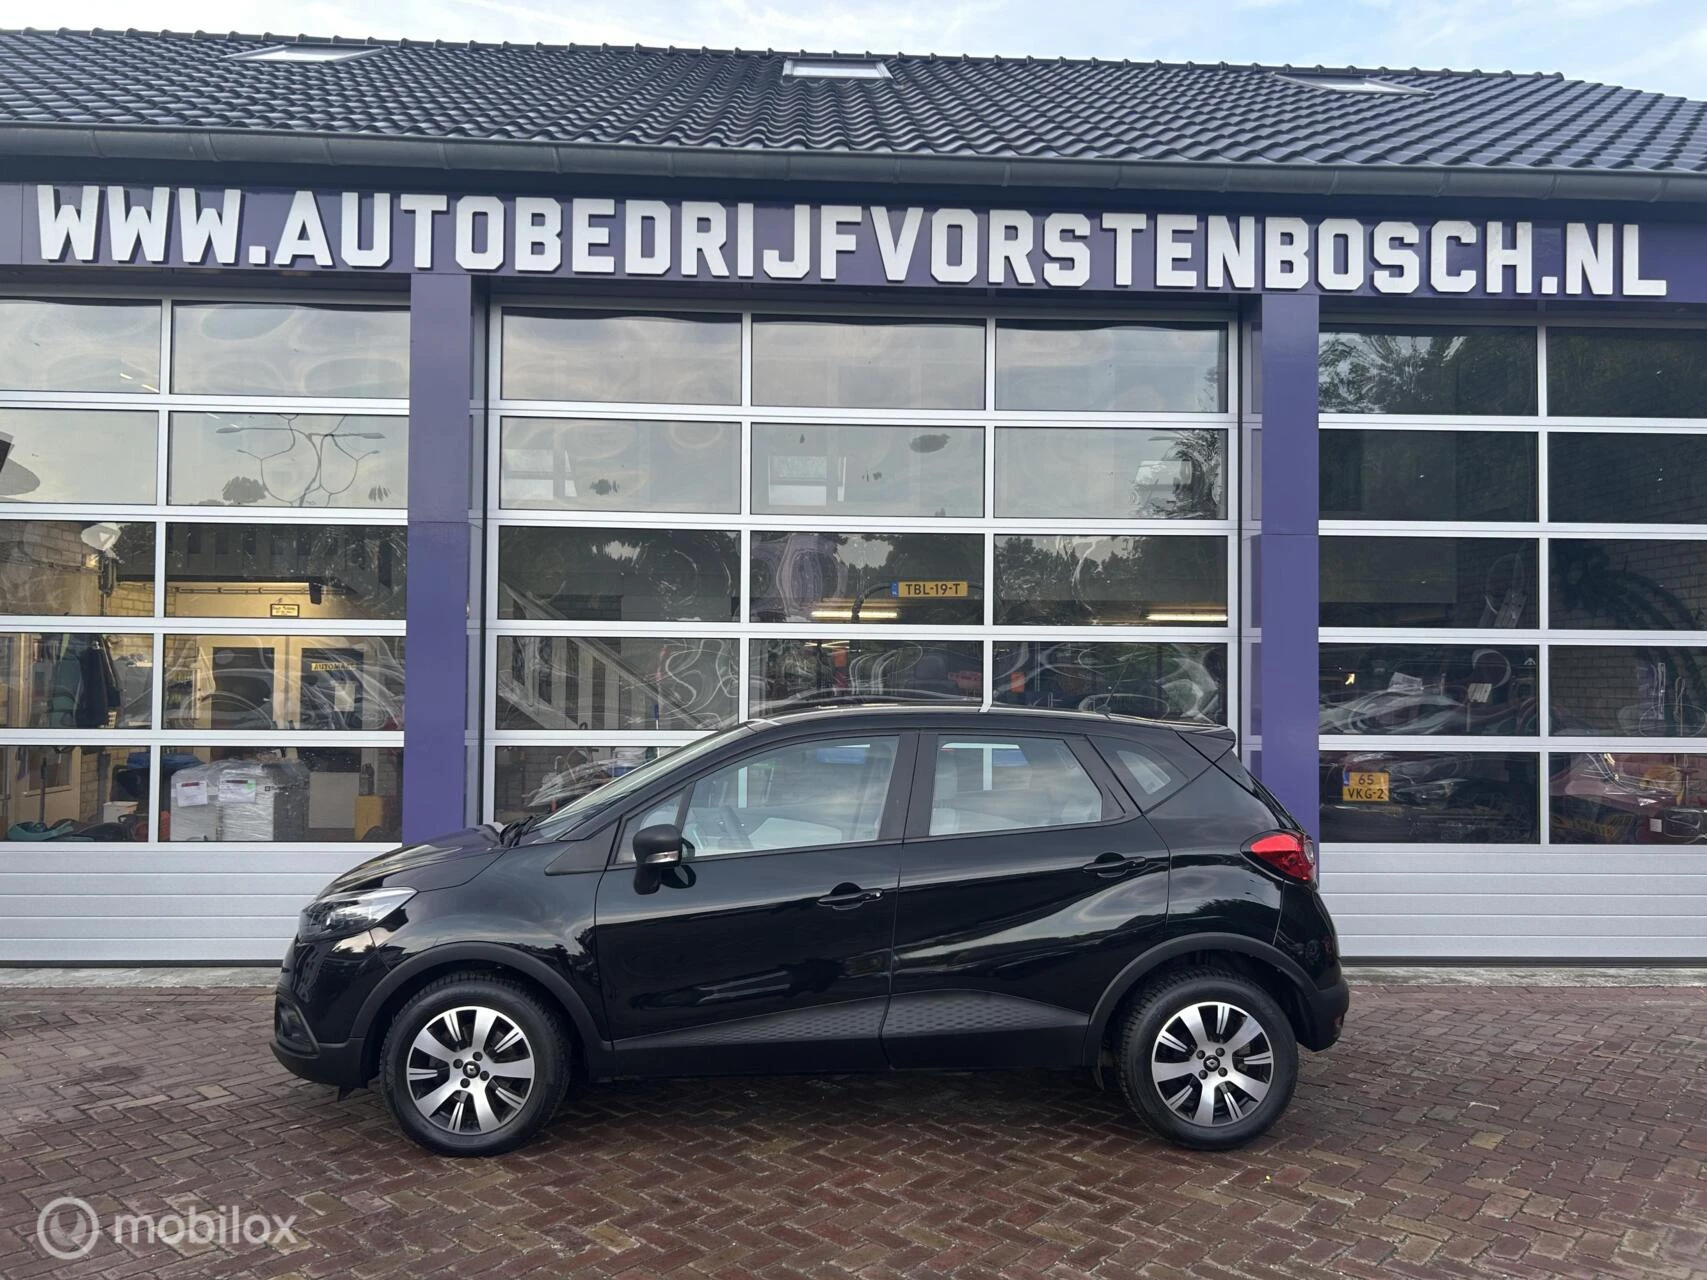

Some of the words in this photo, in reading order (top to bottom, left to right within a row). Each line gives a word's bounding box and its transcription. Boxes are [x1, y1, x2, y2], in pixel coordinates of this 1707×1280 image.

[37, 184, 1668, 296] WWW.AUTOBEDRIJFVORSTENBOSCH.NL
[905, 583, 960, 595] TBL-19-T
[1358, 774, 1375, 785] 65
[1347, 788, 1384, 799] VKG-2
